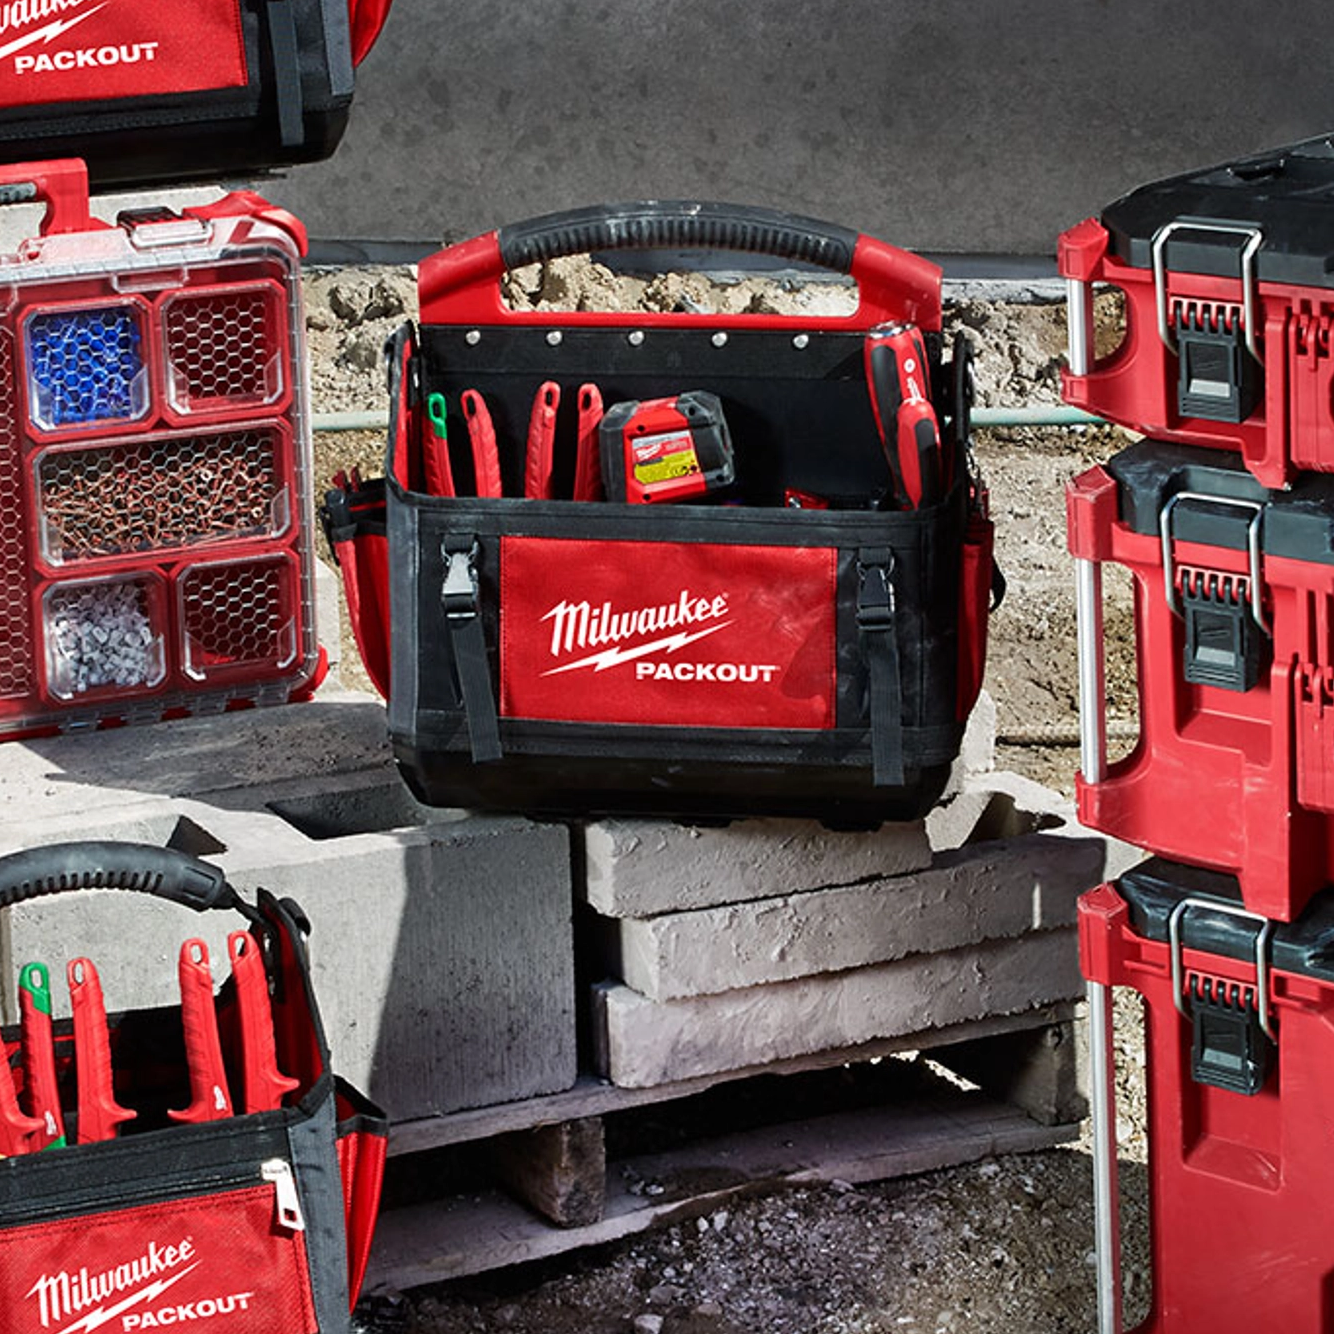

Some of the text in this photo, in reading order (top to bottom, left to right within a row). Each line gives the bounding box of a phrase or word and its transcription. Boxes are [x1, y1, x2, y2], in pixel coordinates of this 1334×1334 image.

[14, 41, 159, 75] PACKOUT
[539, 589, 729, 657] Milwaukee
[635, 662, 777, 683] PACKOUT
[24, 1240, 196, 1328] Milwaukee
[122, 1292, 255, 1333] PACKOUT
